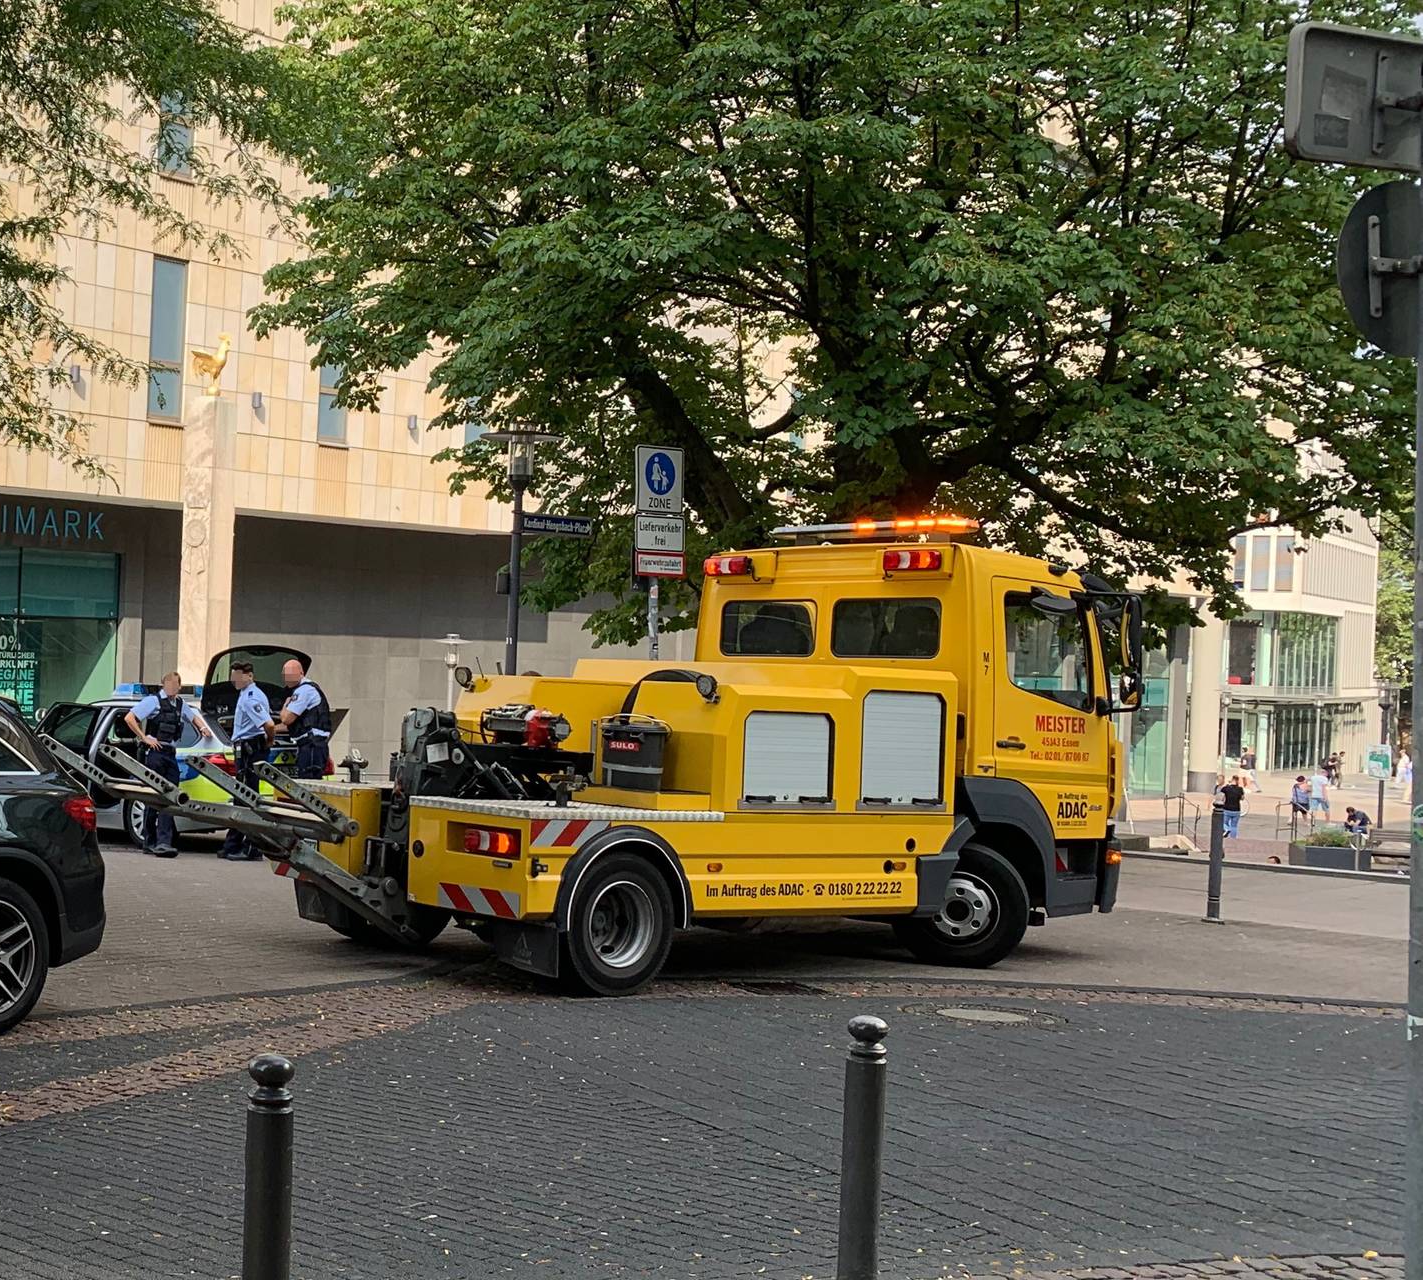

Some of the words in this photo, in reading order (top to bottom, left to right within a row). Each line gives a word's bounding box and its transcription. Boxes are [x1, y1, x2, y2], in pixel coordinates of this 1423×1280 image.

[649, 497, 672, 509] ZONE
[639, 521, 682, 533] Lieferverkehr
[654, 535, 667, 546] frei
[1035, 715, 1086, 735] MEISTER
[609, 741, 635, 750] SULO
[1062, 738, 1080, 747] Essen
[1057, 802, 1088, 819] ADAC
[706, 884, 718, 897] Im
[721, 884, 757, 898] Auftrag
[760, 884, 776, 896] des
[778, 883, 804, 896] ADAC
[828, 883, 853, 896] 0180
